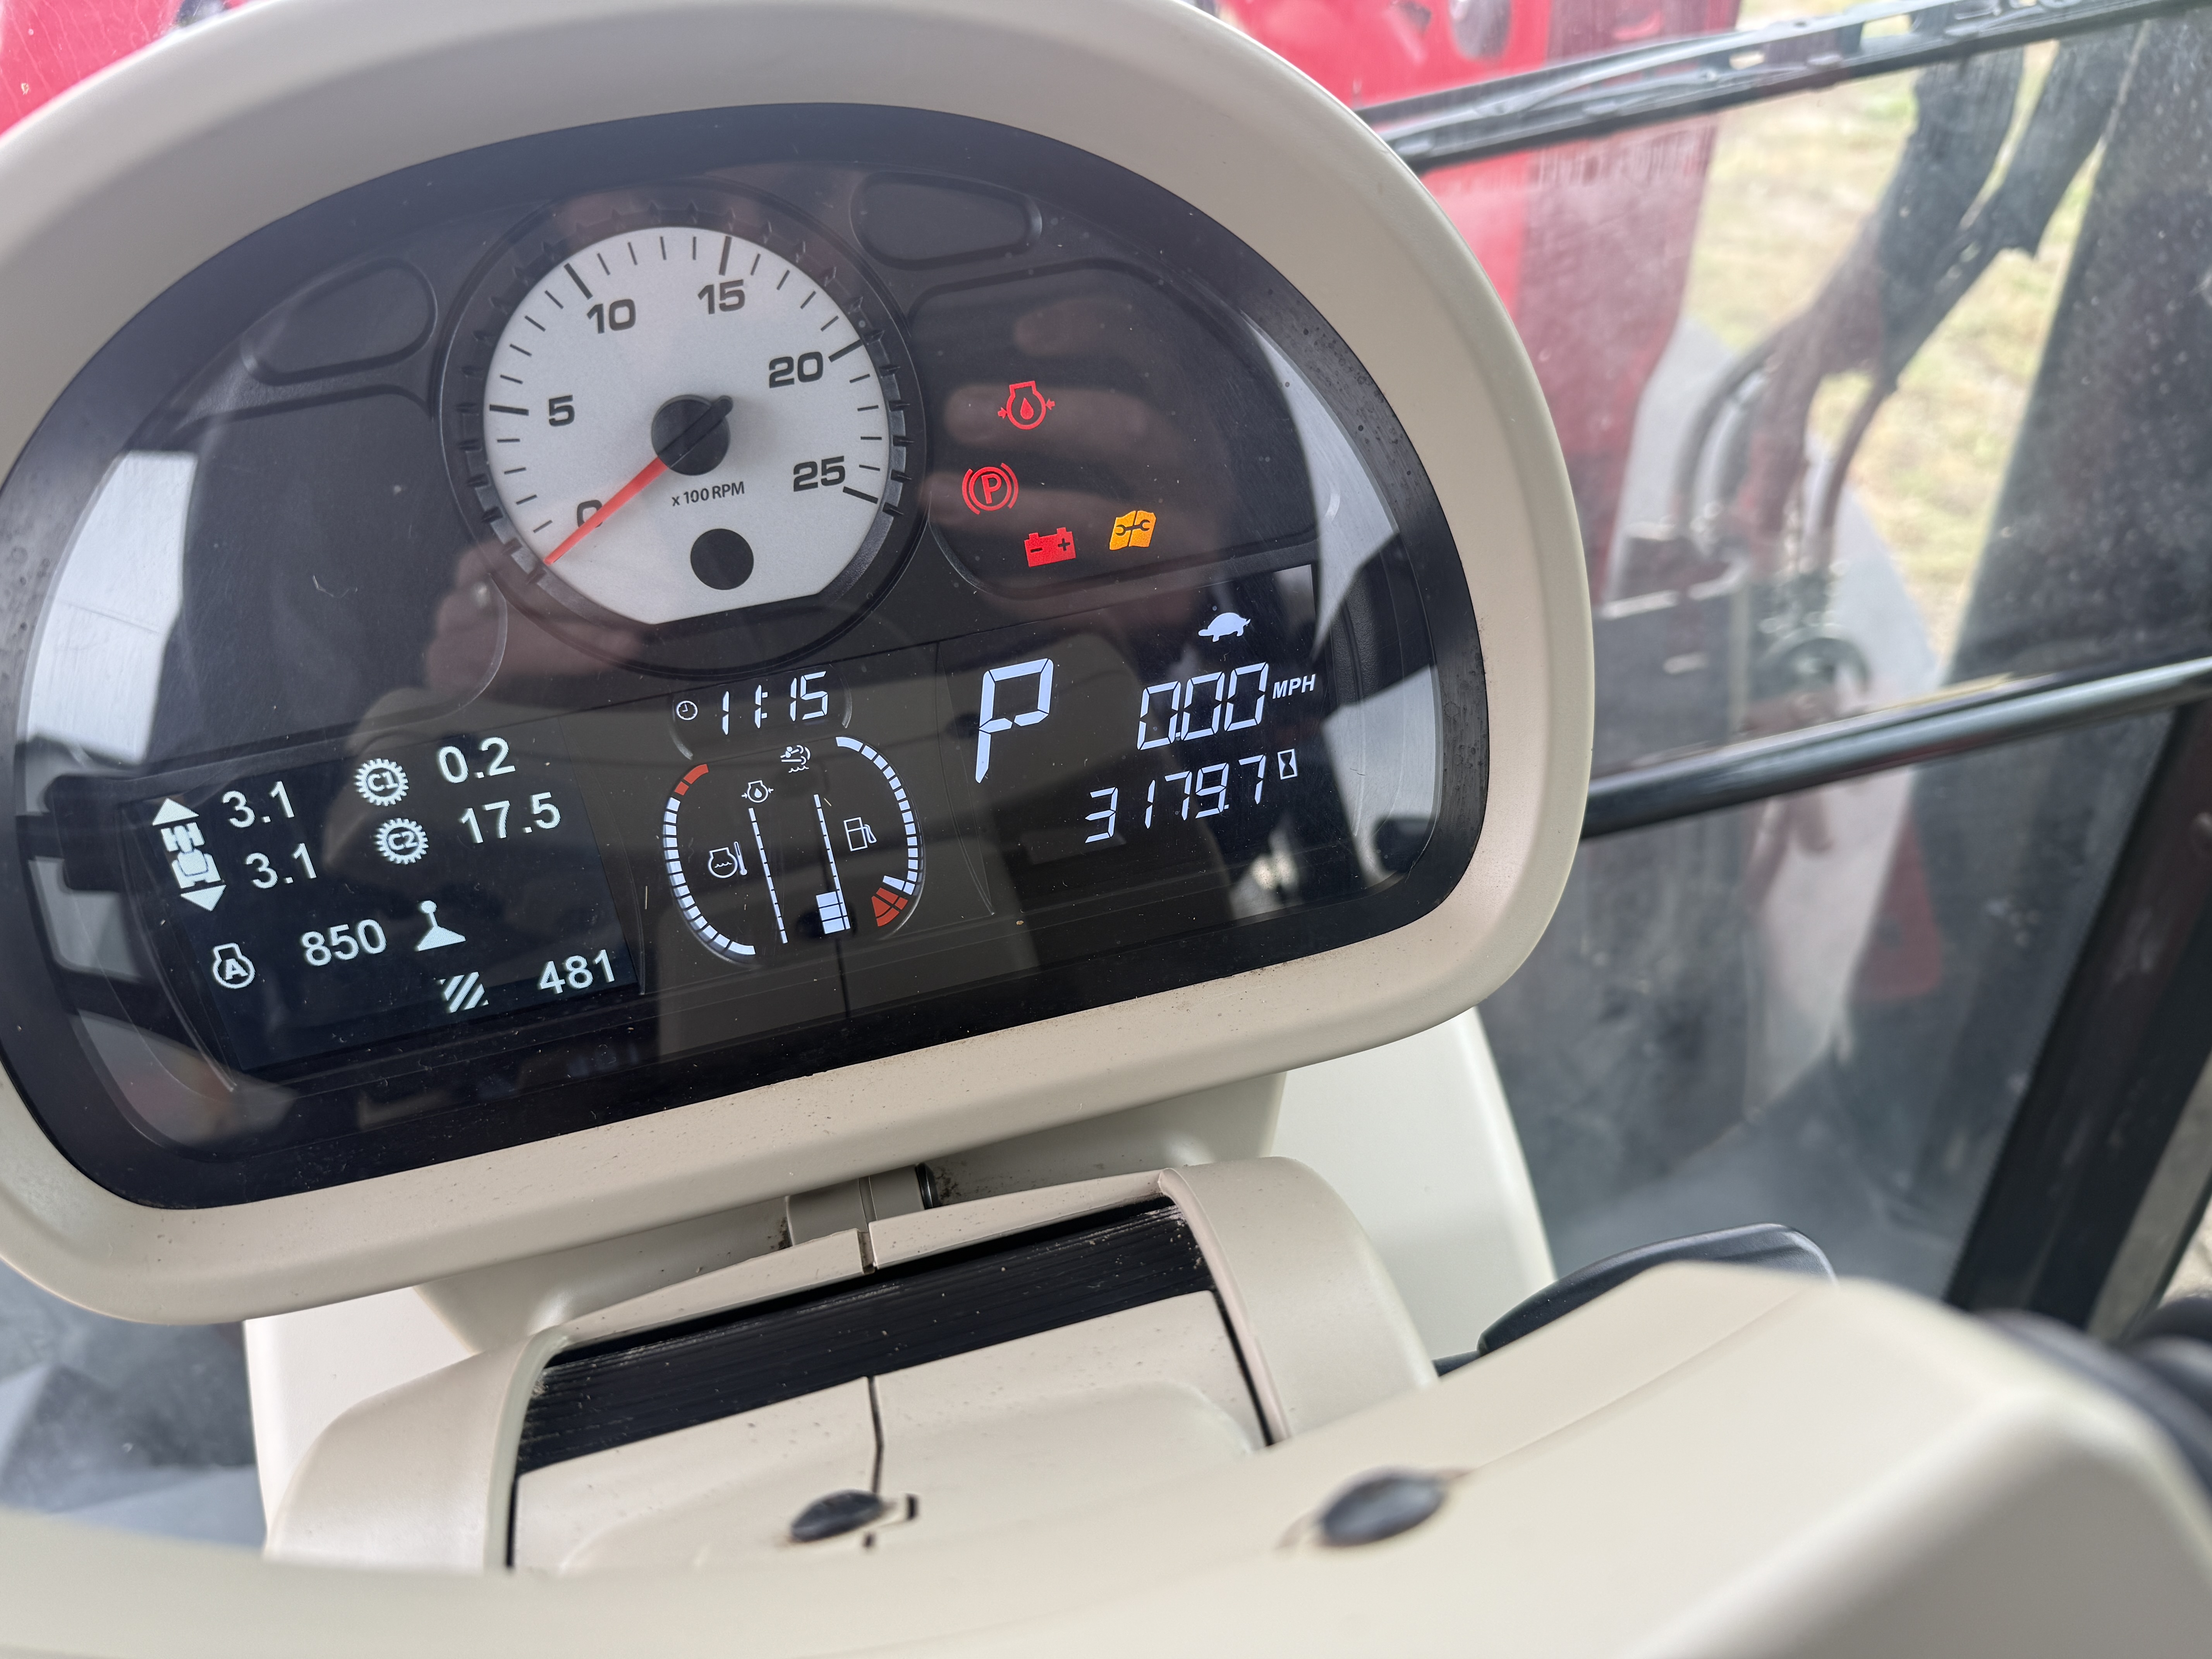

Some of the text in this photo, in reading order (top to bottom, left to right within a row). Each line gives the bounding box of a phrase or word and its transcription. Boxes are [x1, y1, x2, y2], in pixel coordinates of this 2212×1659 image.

[698, 280, 745, 314] 15
[586, 299, 636, 333] 10
[769, 352, 823, 387] 20
[549, 395, 575, 427] 5
[793, 456, 845, 491] 25
[982, 474, 1001, 503] P
[683, 487, 709, 504] 100
[712, 482, 745, 500] RPM
[722, 671, 828, 735] 11:15
[1273, 674, 1315, 699] MPH
[975, 658, 1053, 783] P
[437, 737, 515, 783] 0.2
[368, 771, 398, 792] C1
[222, 781, 295, 828] 3.1
[459, 792, 562, 843] 17.5
[388, 831, 418, 850] C2
[245, 843, 316, 889] 3.1
[300, 919, 386, 966] 850
[225, 958, 248, 980] A
[538, 950, 615, 994] 481
